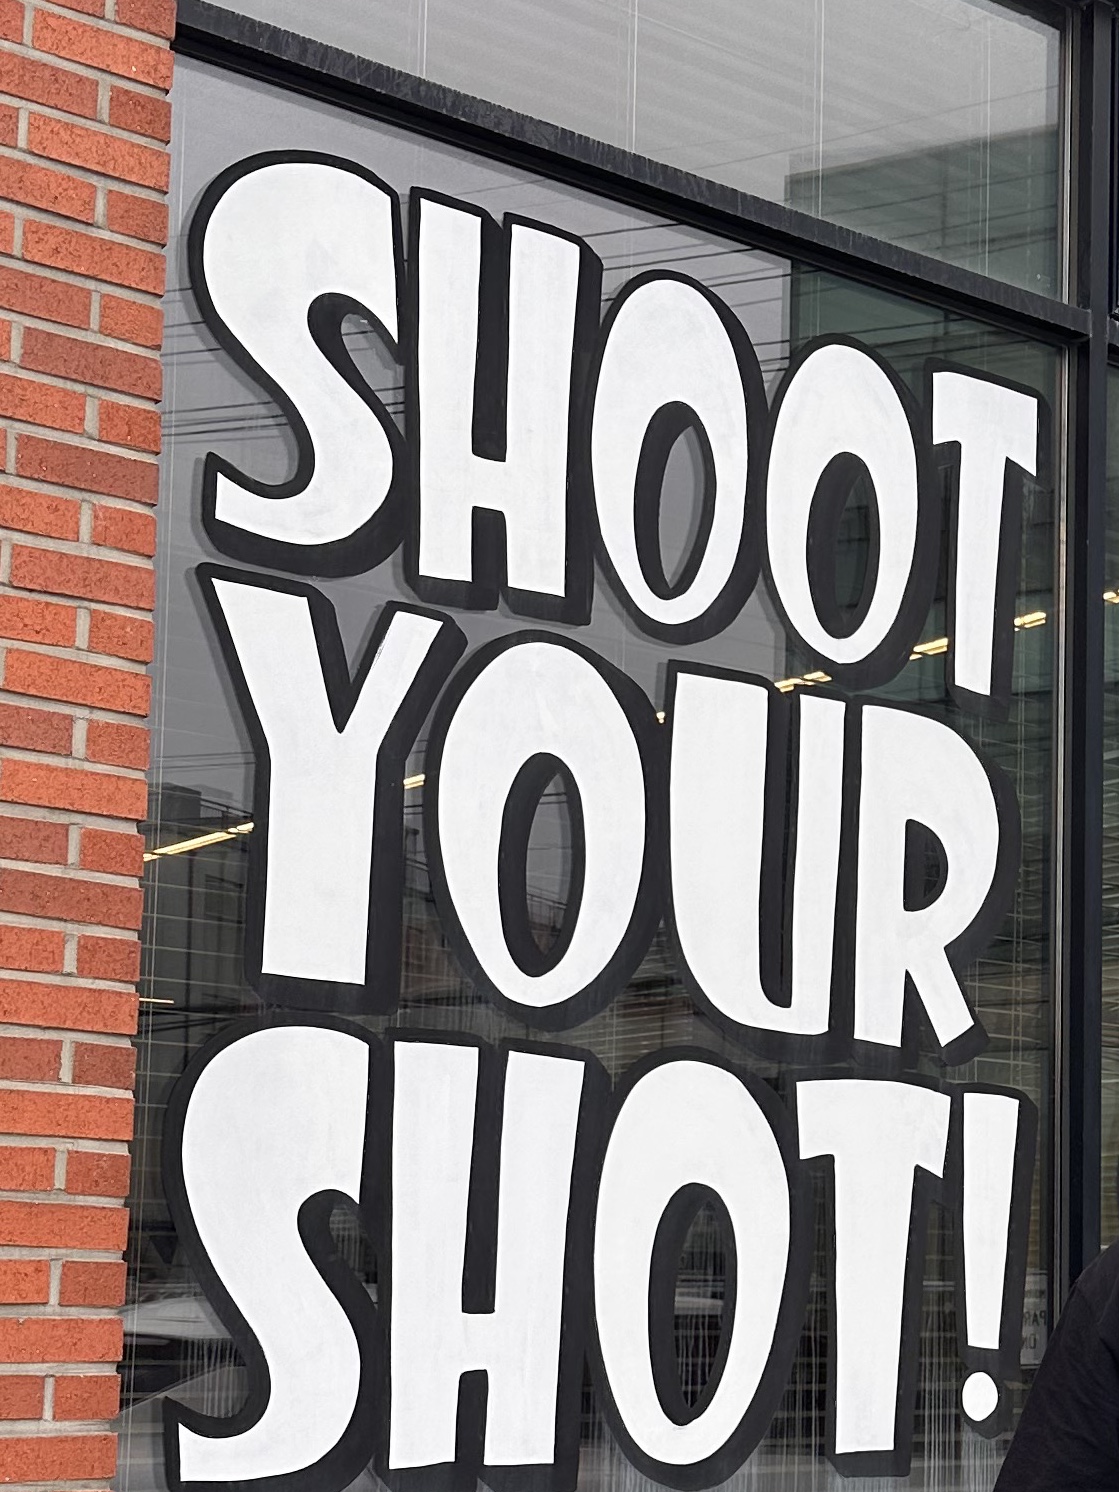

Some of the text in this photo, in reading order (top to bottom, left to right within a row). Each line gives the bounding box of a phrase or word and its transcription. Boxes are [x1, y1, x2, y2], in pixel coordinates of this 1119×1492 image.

[202, 161, 1039, 697] SHOOT
[210, 576, 1001, 1050] YOUR
[177, 1024, 1021, 1483] SHOT!
